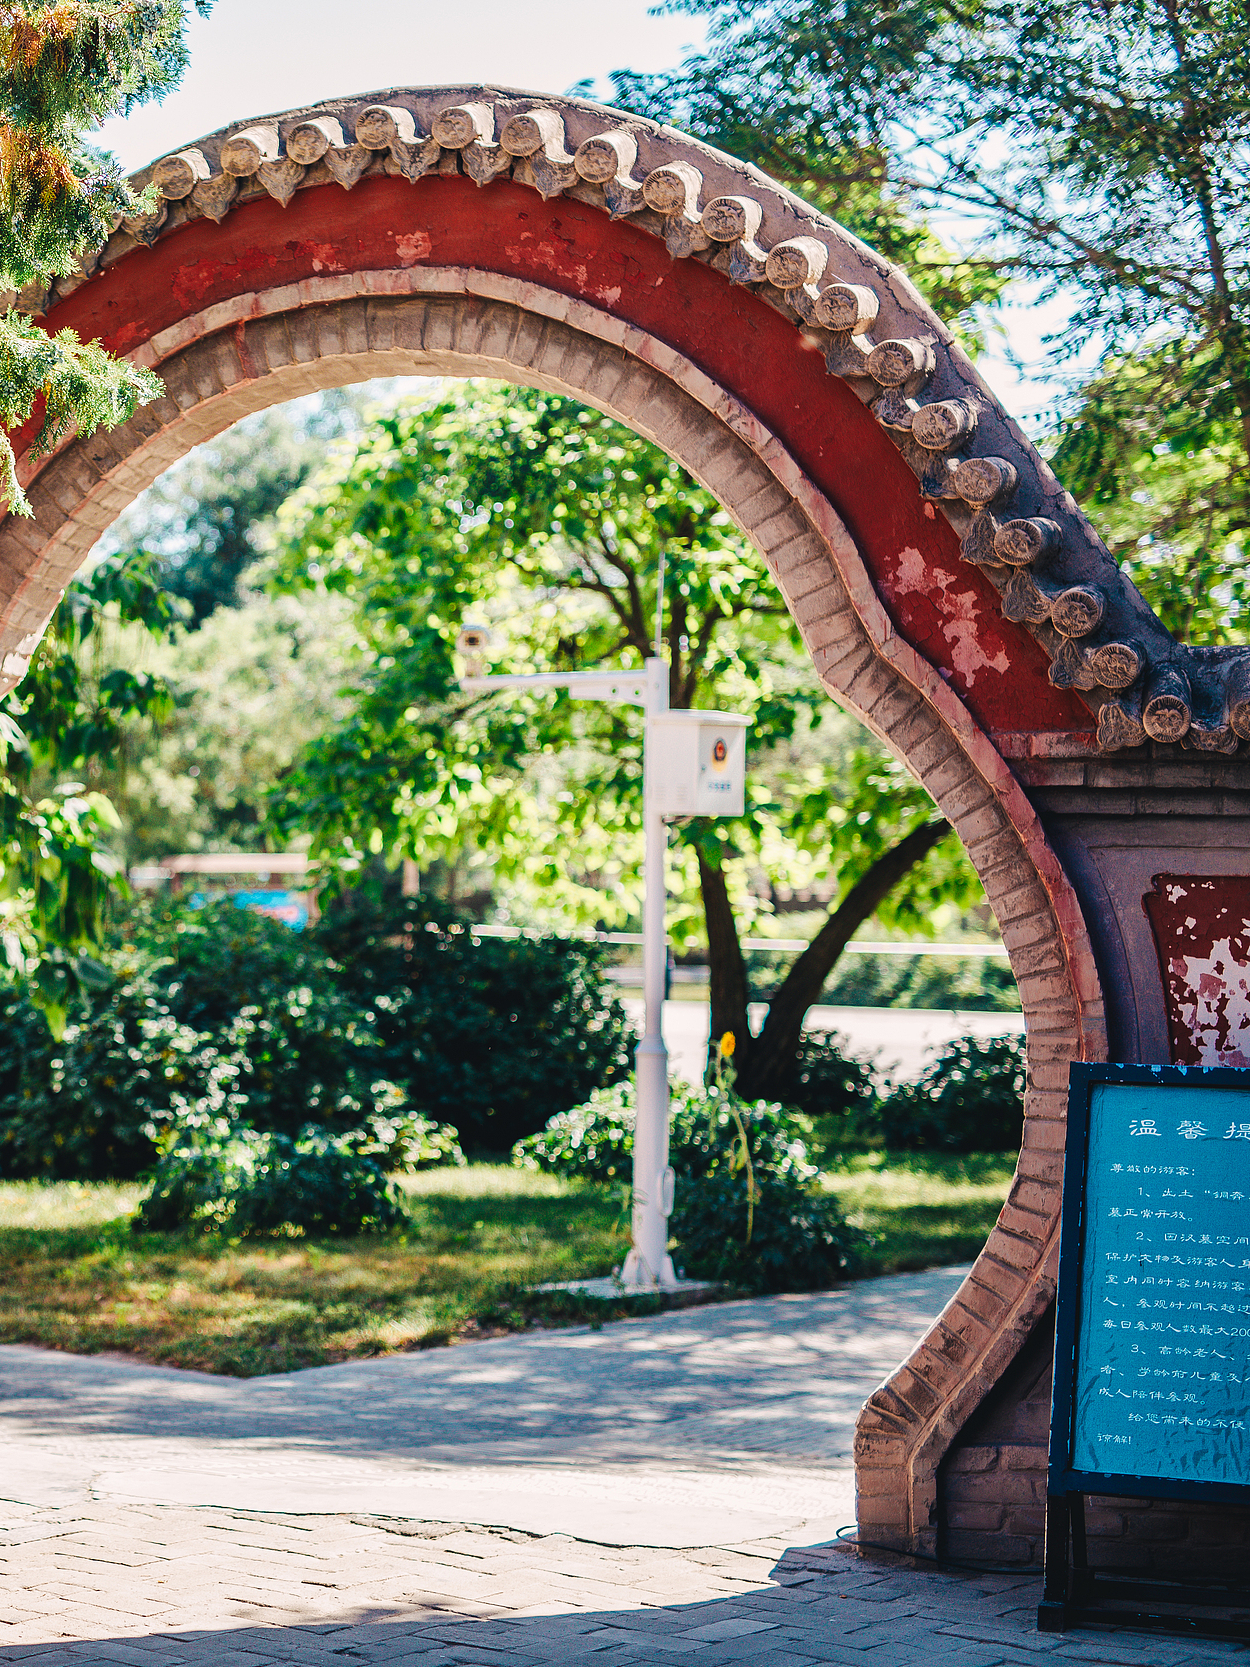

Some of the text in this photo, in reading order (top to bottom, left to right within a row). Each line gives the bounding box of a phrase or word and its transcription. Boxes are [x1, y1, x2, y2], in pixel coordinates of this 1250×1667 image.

[1129, 1119, 1250, 1140] 温馨提
[1108, 1207, 1193, 1222] 墓正常开放。
[1105, 1274, 1250, 1292] 室内同时容纳游客
[1131, 1344, 1250, 1361] 3、高龄老人、
[1098, 1387, 1206, 1405] 成人陪伴参观。
[1128, 1413, 1246, 1430] 给您带来的不便
